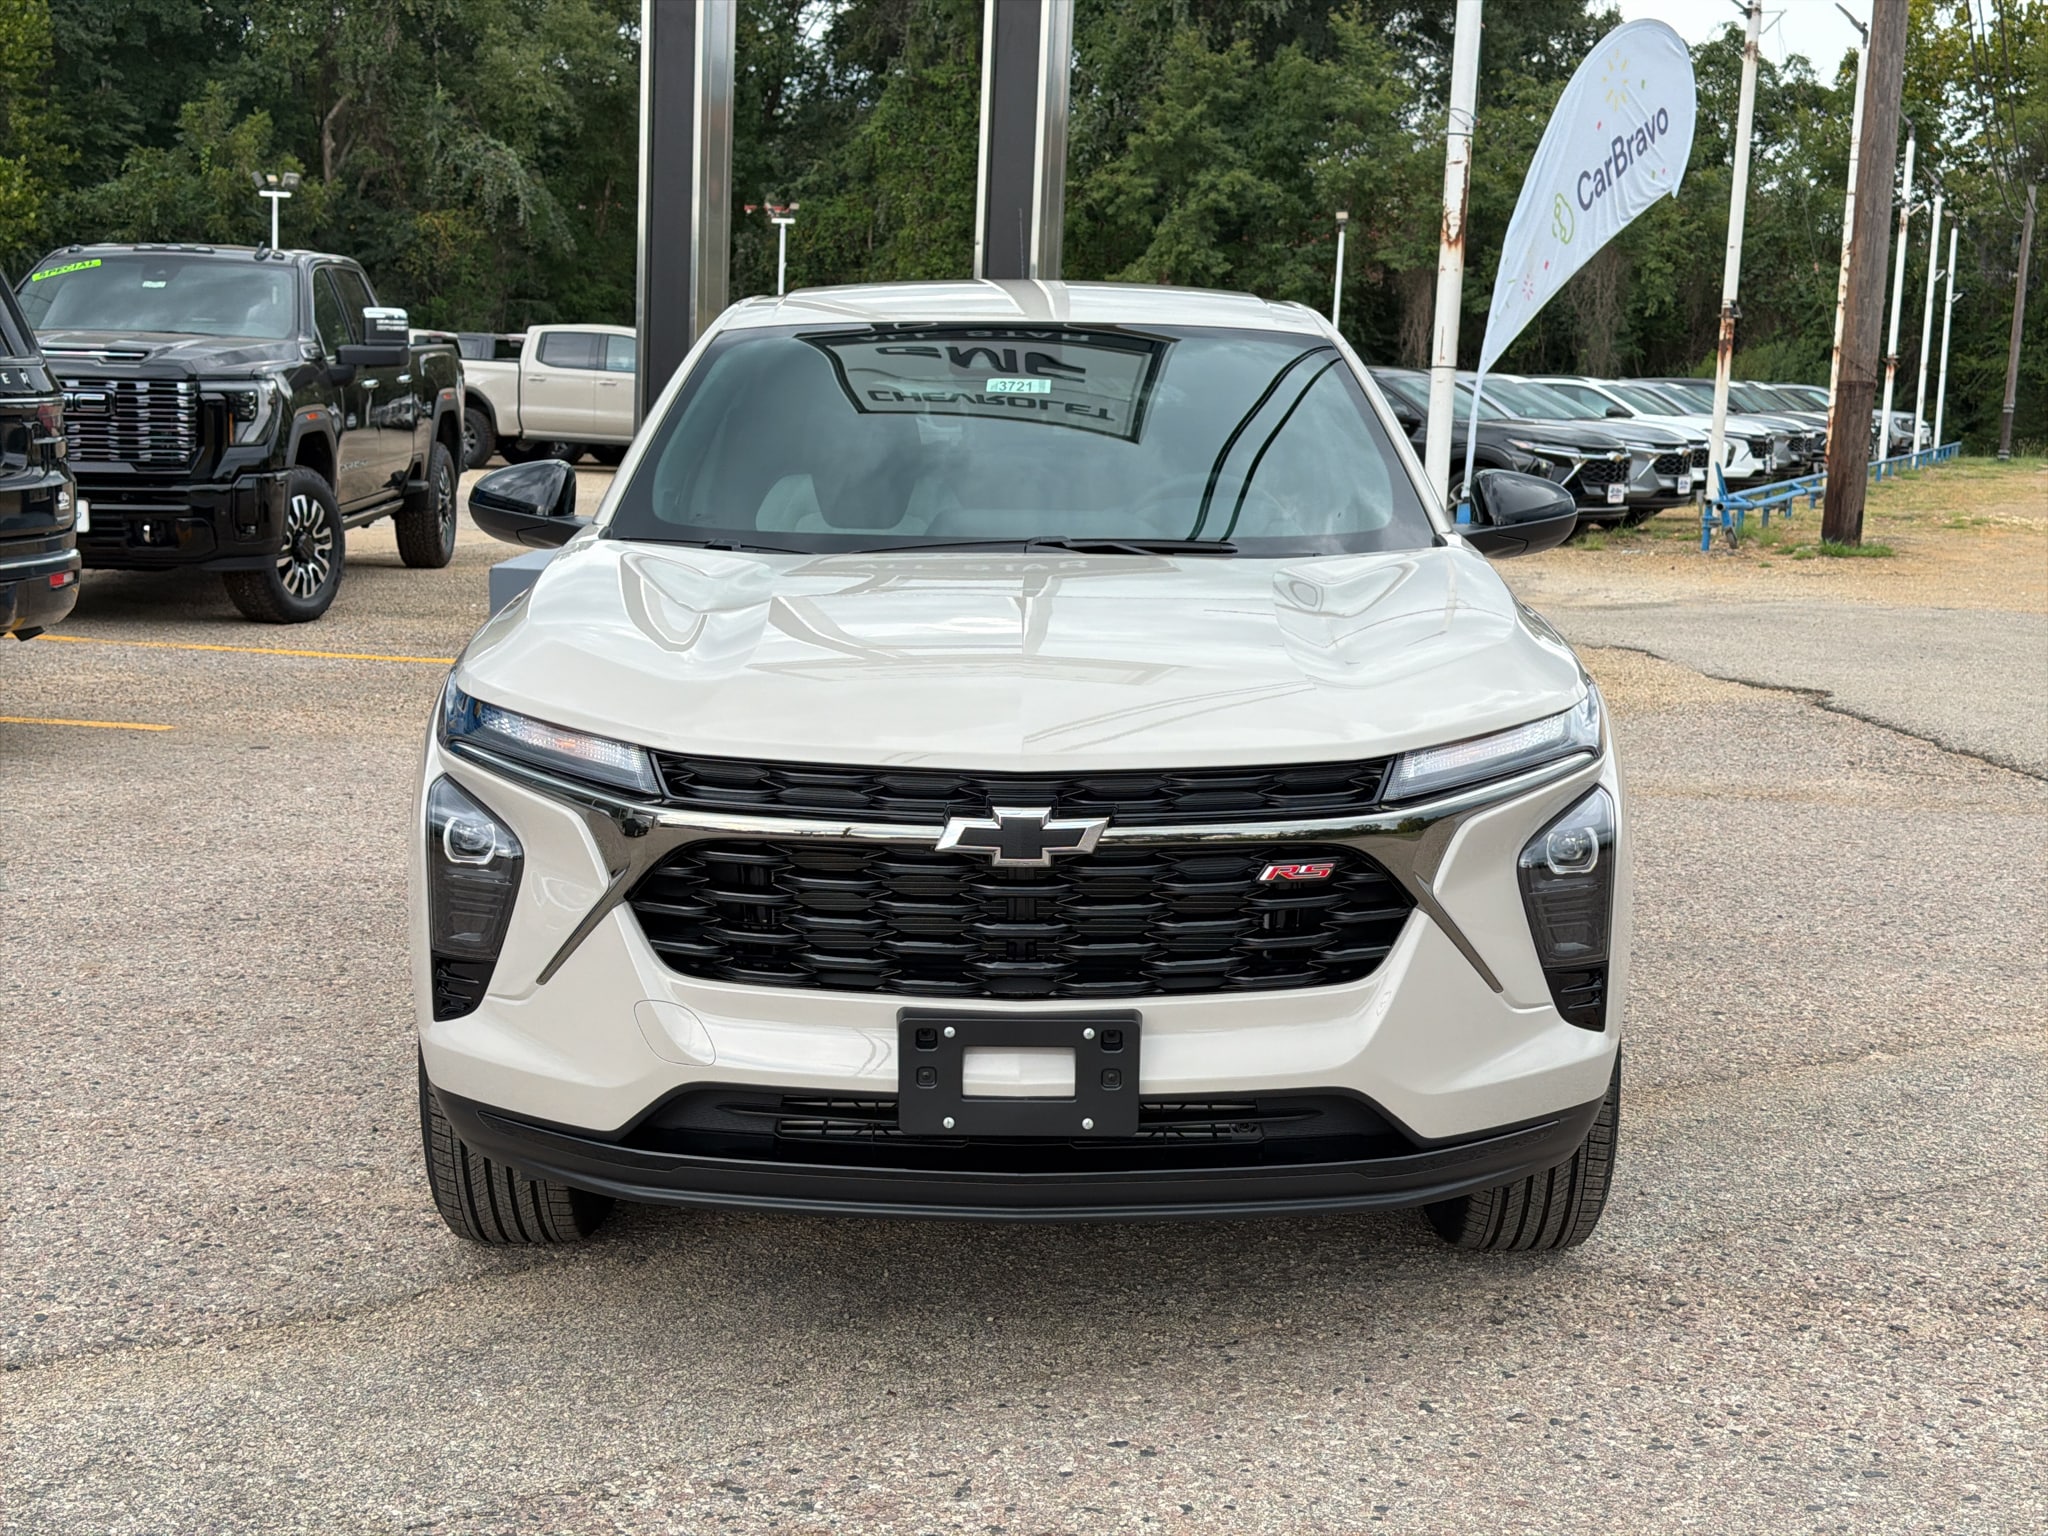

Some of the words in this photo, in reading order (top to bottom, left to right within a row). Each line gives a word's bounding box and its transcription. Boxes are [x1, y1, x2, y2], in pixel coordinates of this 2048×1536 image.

[1577, 107, 1669, 212] CarBravo
[999, 380, 1033, 392] 3721
[1258, 862, 1335, 881] RS
